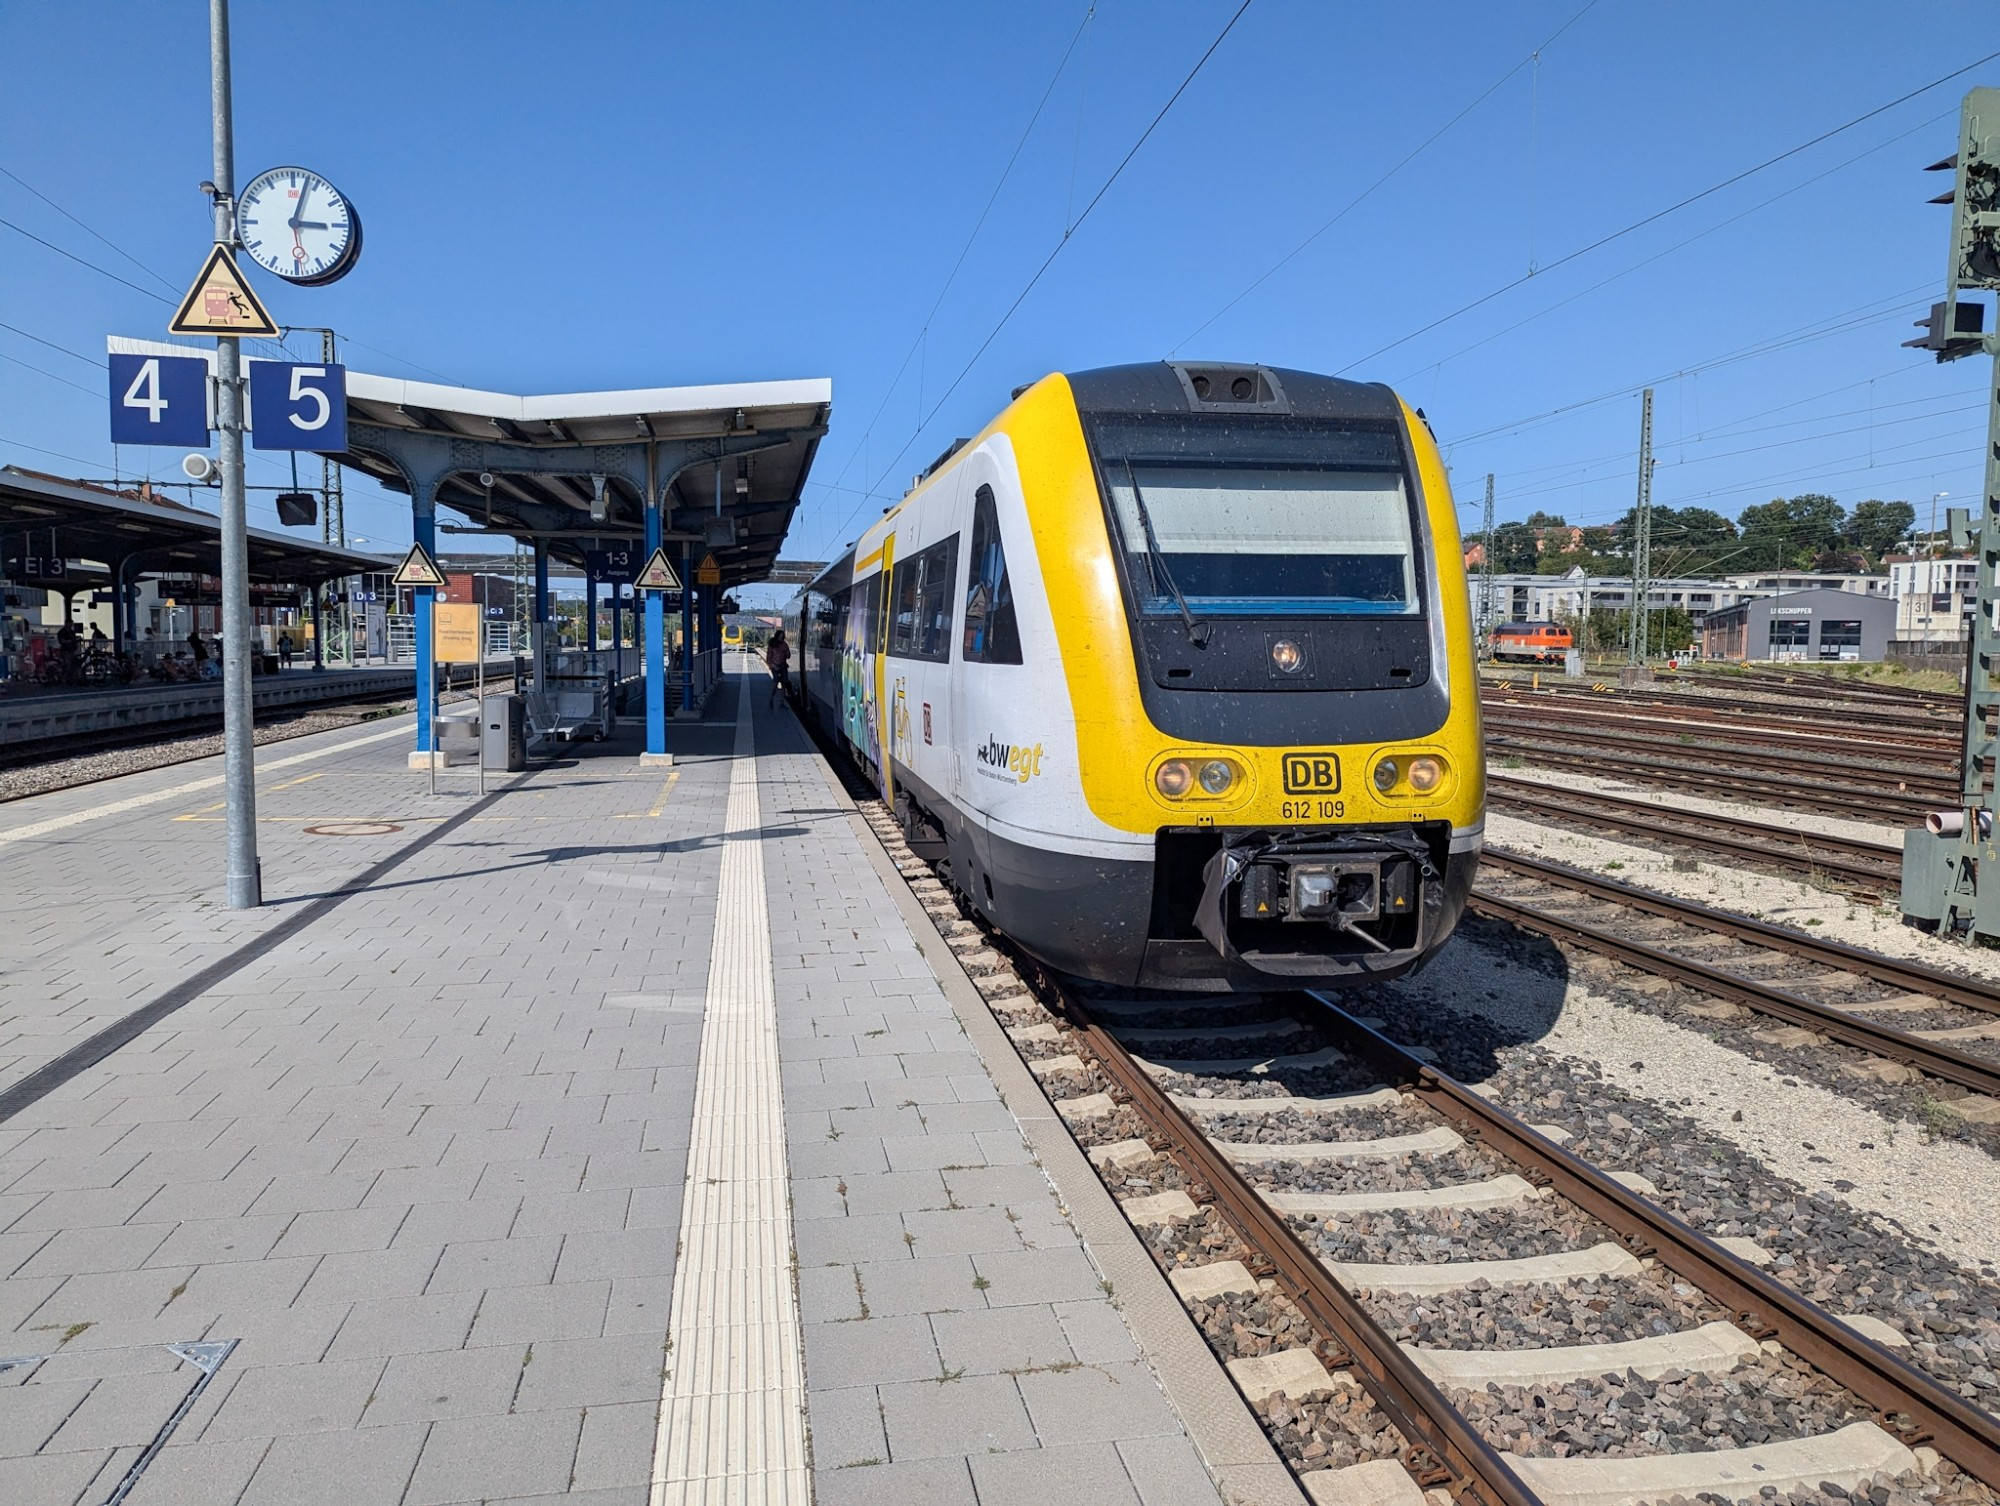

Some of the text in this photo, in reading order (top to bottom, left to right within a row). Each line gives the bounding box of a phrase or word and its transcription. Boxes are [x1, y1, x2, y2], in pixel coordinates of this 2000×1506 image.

[123, 359, 168, 423] 4
[288, 367, 331, 431] 5
[25, 557, 63, 575] E 3
[606, 551, 629, 565] 1-3
[356, 592, 376, 600] D 3
[1915, 601, 1926, 612] 31
[989, 732, 1043, 783] bwegt
[1290, 758, 1334, 789] DB
[1282, 801, 1345, 819] 612 109
